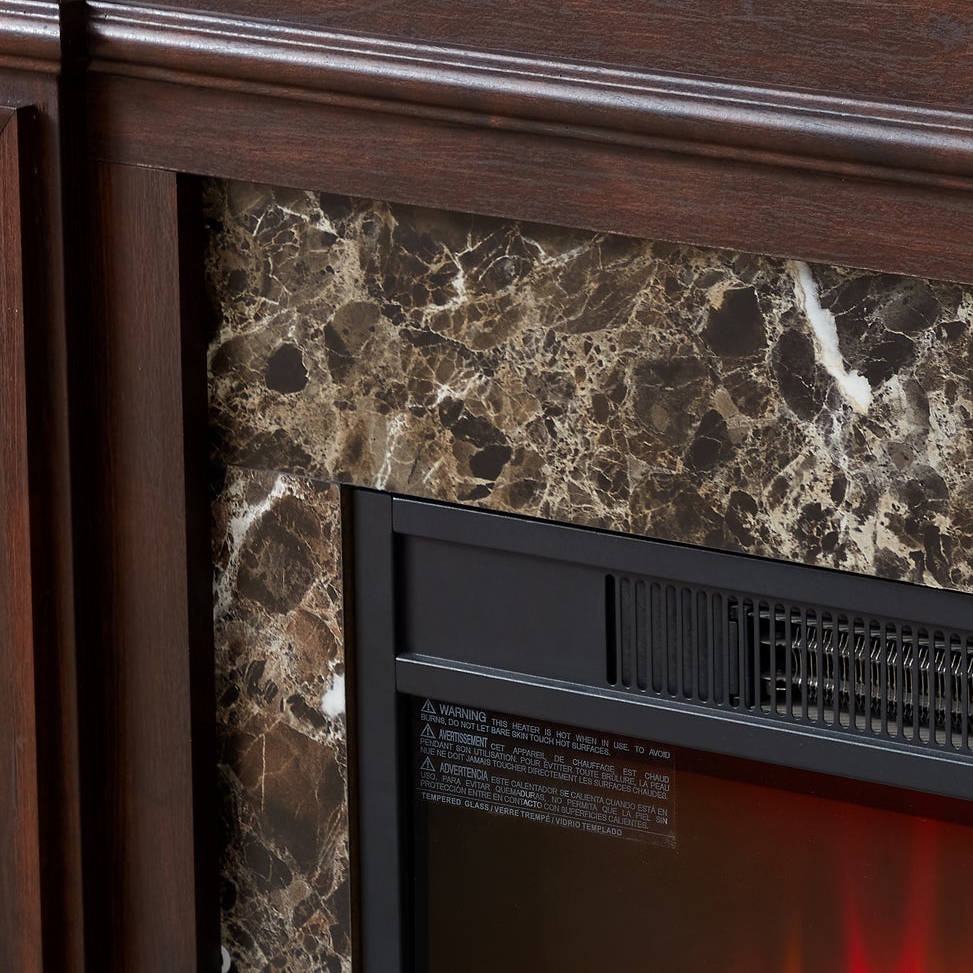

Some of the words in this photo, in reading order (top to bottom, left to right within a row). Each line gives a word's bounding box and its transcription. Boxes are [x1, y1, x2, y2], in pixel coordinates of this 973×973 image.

[420, 714, 446, 726] BURNS,
[460, 721, 476, 730] NOT
[477, 724, 490, 733] LET
[490, 726, 510, 737] BARE
[512, 730, 529, 740] SKIN
[529, 734, 554, 746] TOUCH
[556, 738, 571, 748] HOT
[572, 742, 610, 756] SURFACES.
[440, 704, 486, 723] WARNING
[491, 718, 508, 728] THIS
[512, 722, 540, 734] HEATER
[544, 729, 552, 737] IS
[556, 731, 571, 740] HOT
[576, 734, 597, 745] WHEN
[634, 746, 644, 754] TO
[649, 749, 670, 759] AVOID
[420, 738, 453, 750] PENDANT
[456, 745, 471, 754] SON
[520, 757, 540, 767] POUR
[576, 767, 600, 778] TOUTE
[650, 782, 670, 792] PEAU
[420, 747, 435, 756] NUE
[448, 752, 464, 761] DOIT
[466, 756, 490, 766] JAMAIS
[492, 759, 526, 772] TOUCHER
[528, 766, 578, 782] DIRECTEMENT
[579, 776, 592, 786] LES
[594, 780, 632, 793] SURFACES
[632, 787, 668, 800] CHAUDES.
[439, 729, 488, 748] AVERTISSEMENT
[490, 742, 505, 751] CET
[512, 748, 546, 760] APPAREIL
[554, 755, 564, 764] DE
[572, 758, 614, 773] CHAUFFAGE
[623, 768, 637, 777] EST
[644, 772, 670, 784] CHAUD
[440, 762, 488, 781] ADVERTENCIA
[490, 776, 510, 786] ESTE
[511, 780, 558, 795] CALENTADOR
[560, 789, 570, 797] SE
[570, 791, 604, 804] CALIENTA
[606, 798, 636, 810] CUANDO
[442, 776, 461, 785] PARA
[466, 780, 490, 791] EVITAR
[566, 799, 598, 811] PERMITA
[602, 806, 616, 815] QUE
[636, 812, 652, 822] PIEL
[656, 816, 668, 824] SIN
[468, 788, 492, 800] ENTRE
[492, 793, 502, 801] EN
[504, 796, 542, 808] CONTACTO
[544, 803, 560, 812] CON
[561, 806, 607, 821] SUPERFICIES
[608, 816, 648, 829] CALIENTES.
[422, 792, 461, 806] TEMPERED
[464, 800, 489, 811] GLASS
[494, 806, 519, 816] VERRE
[556, 817, 580, 828] VIDRIO
[582, 822, 622, 836] TEMPLADO
